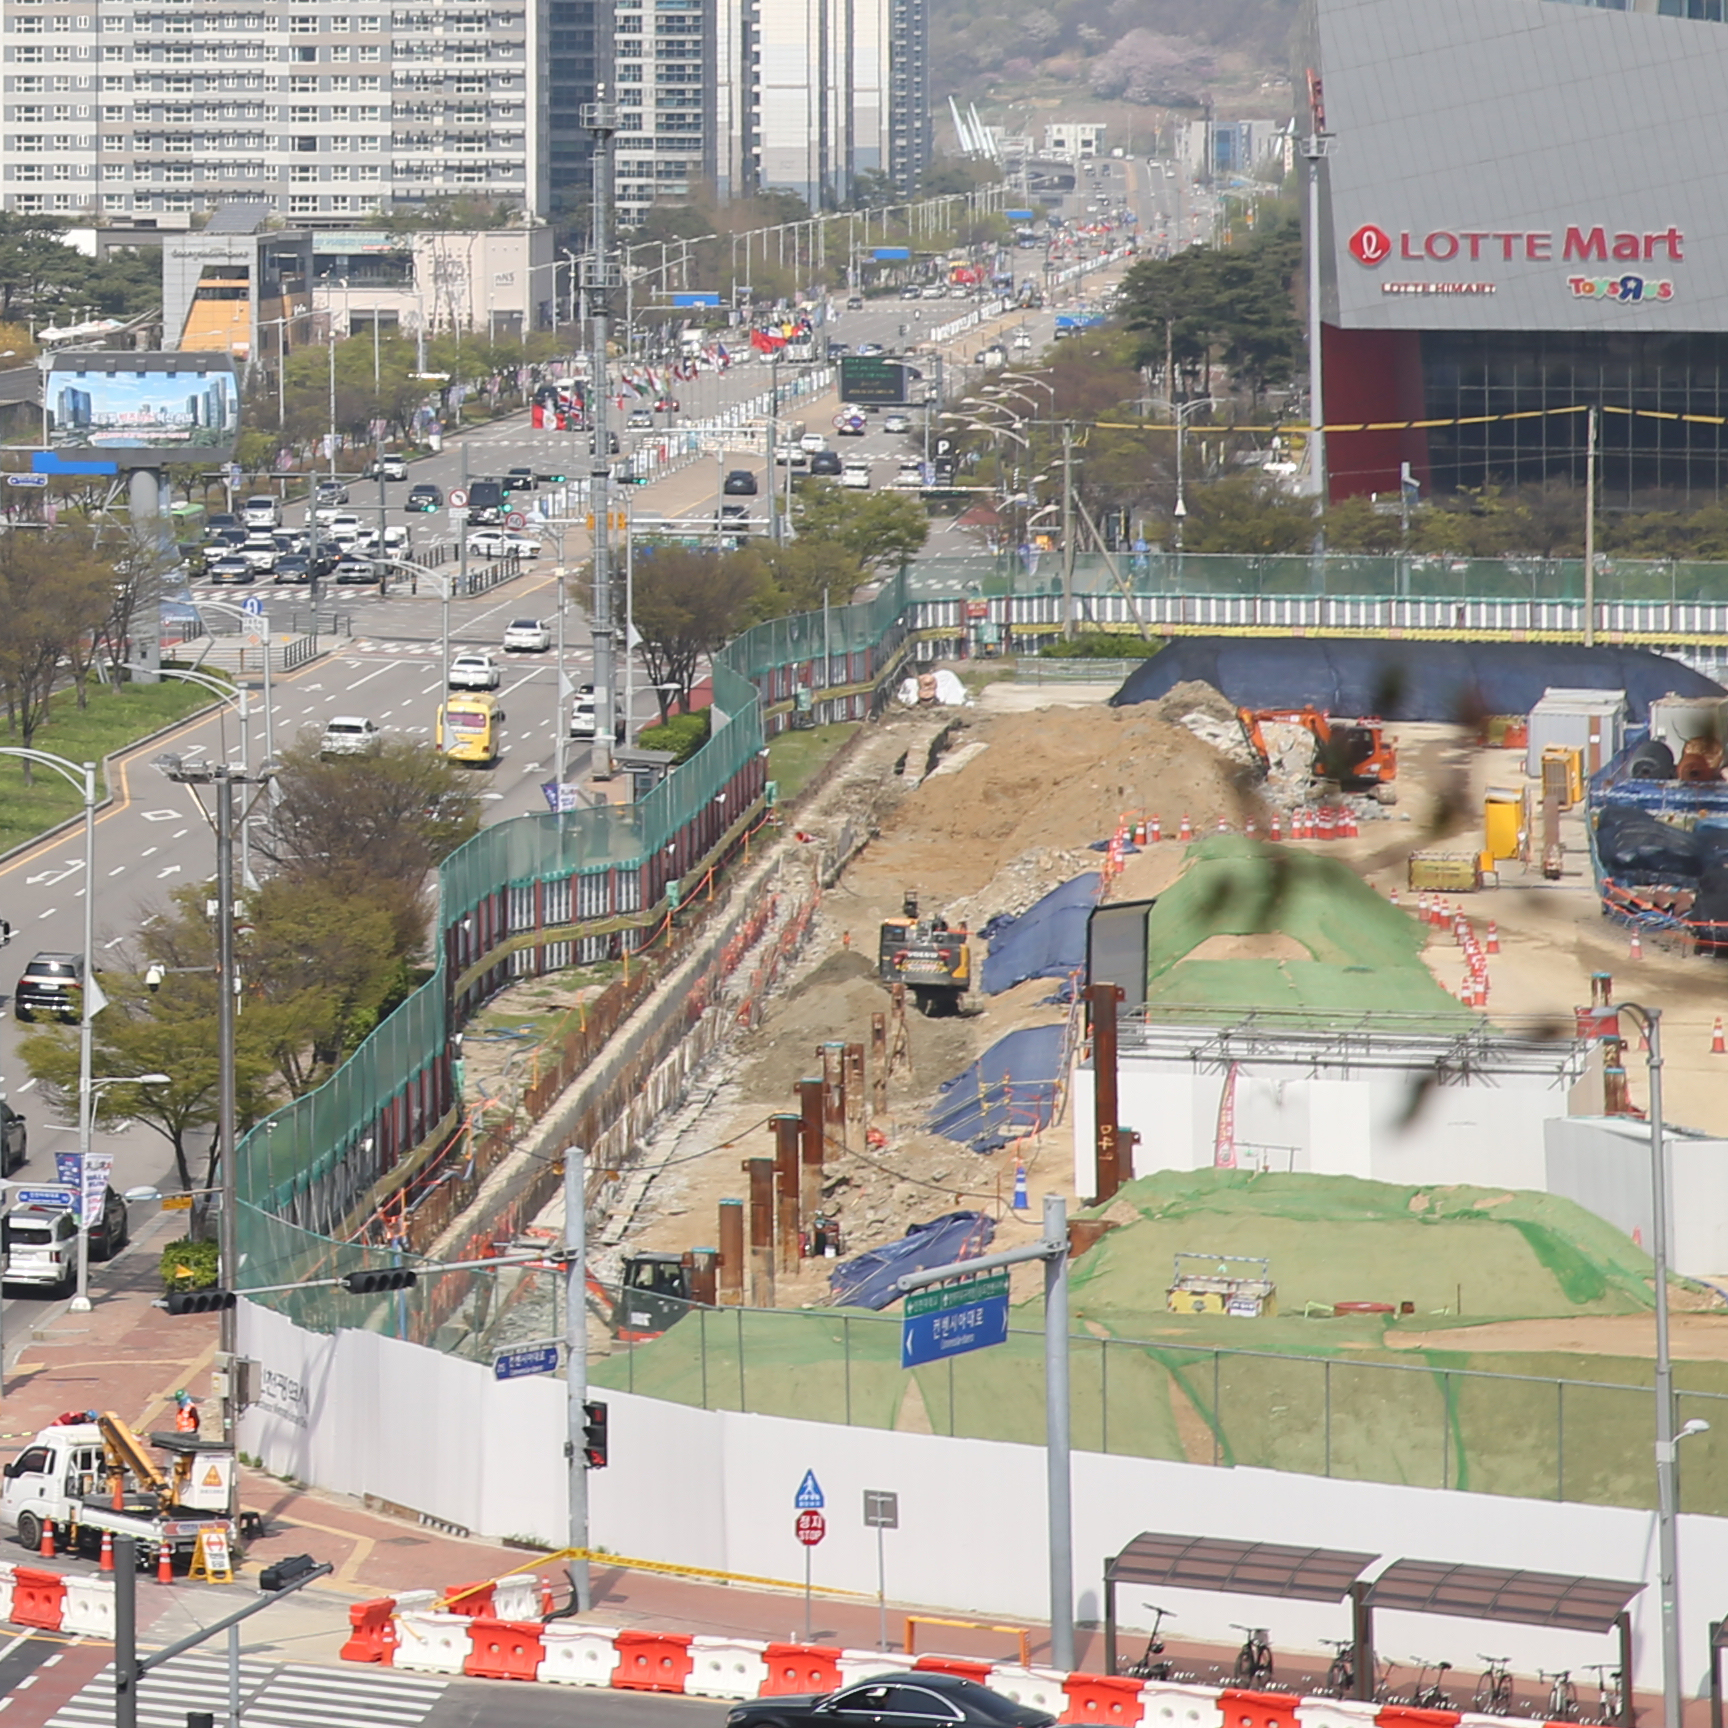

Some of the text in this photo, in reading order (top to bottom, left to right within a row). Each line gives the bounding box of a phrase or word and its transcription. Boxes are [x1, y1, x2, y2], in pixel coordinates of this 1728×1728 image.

[1400, 224, 1684, 262] LOTTE Mart
[1381, 282, 1435, 293] LOTTE
[798, 1515, 823, 1529] 정지
